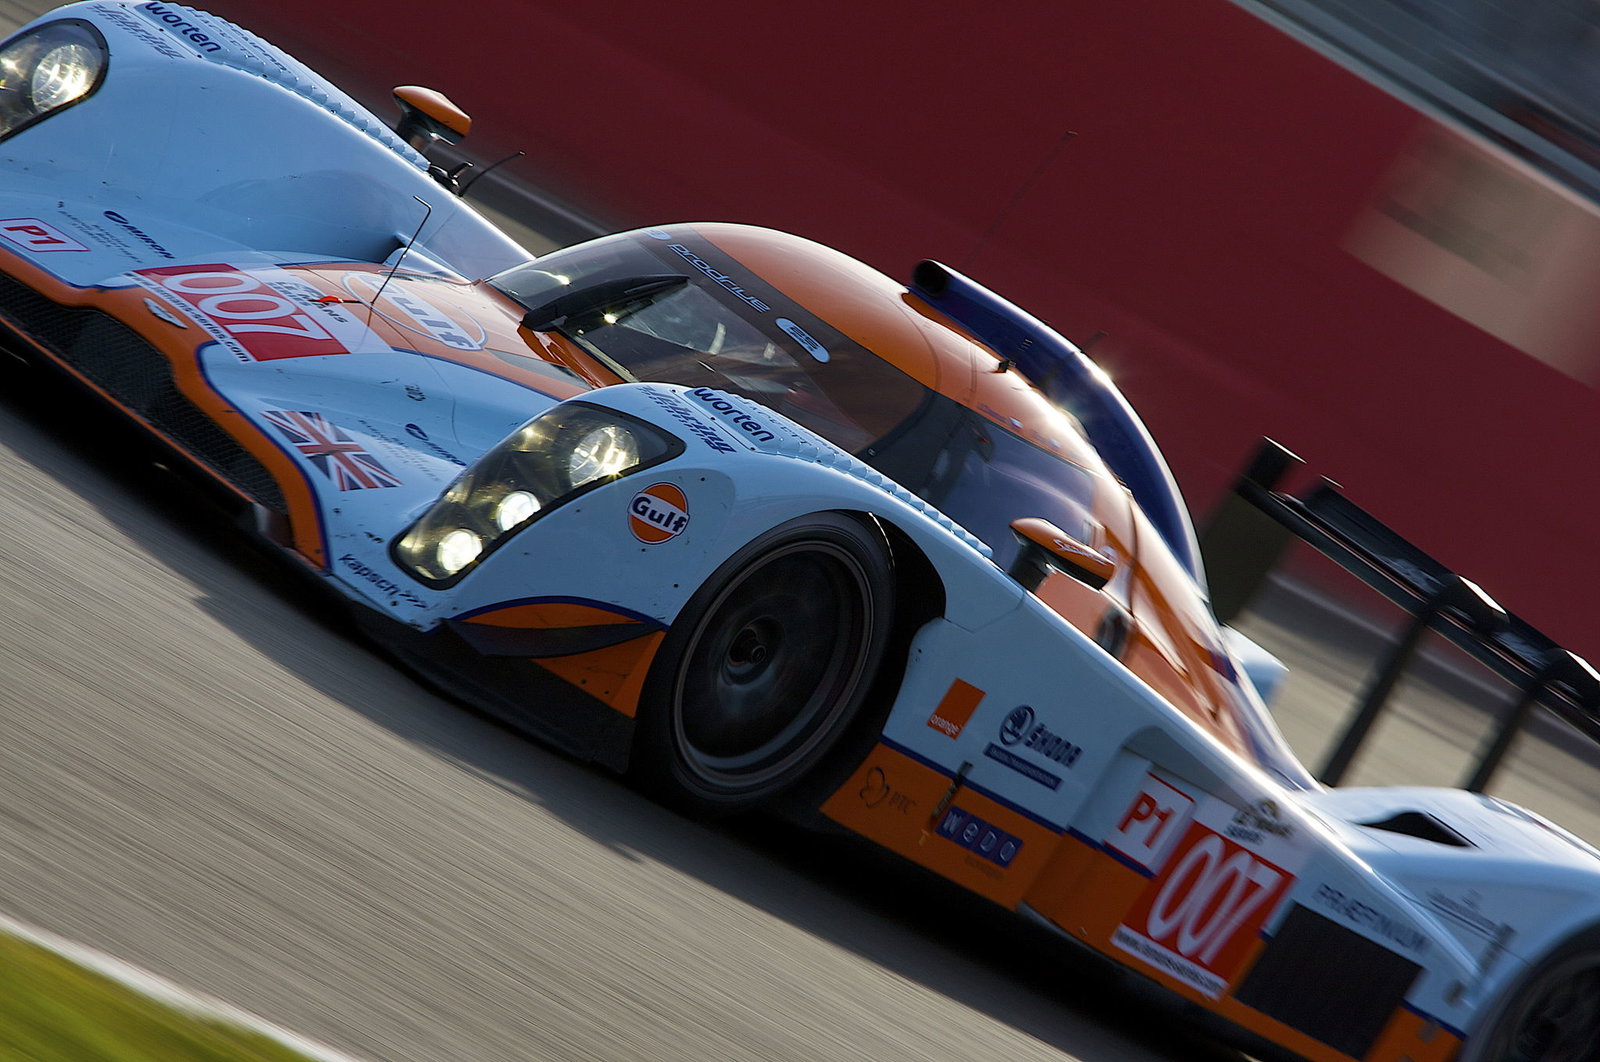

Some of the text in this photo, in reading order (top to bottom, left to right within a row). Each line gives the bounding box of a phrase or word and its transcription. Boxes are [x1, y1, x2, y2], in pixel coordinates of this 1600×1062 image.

[144, 2, 222, 52] worten
[3, 225, 67, 245] P1
[161, 271, 334, 341] 007
[693, 387, 775, 443] worten
[631, 496, 688, 534] Gulf
[338, 552, 401, 599] kapsch
[1116, 790, 1176, 849] P1
[1146, 833, 1285, 967] 007
